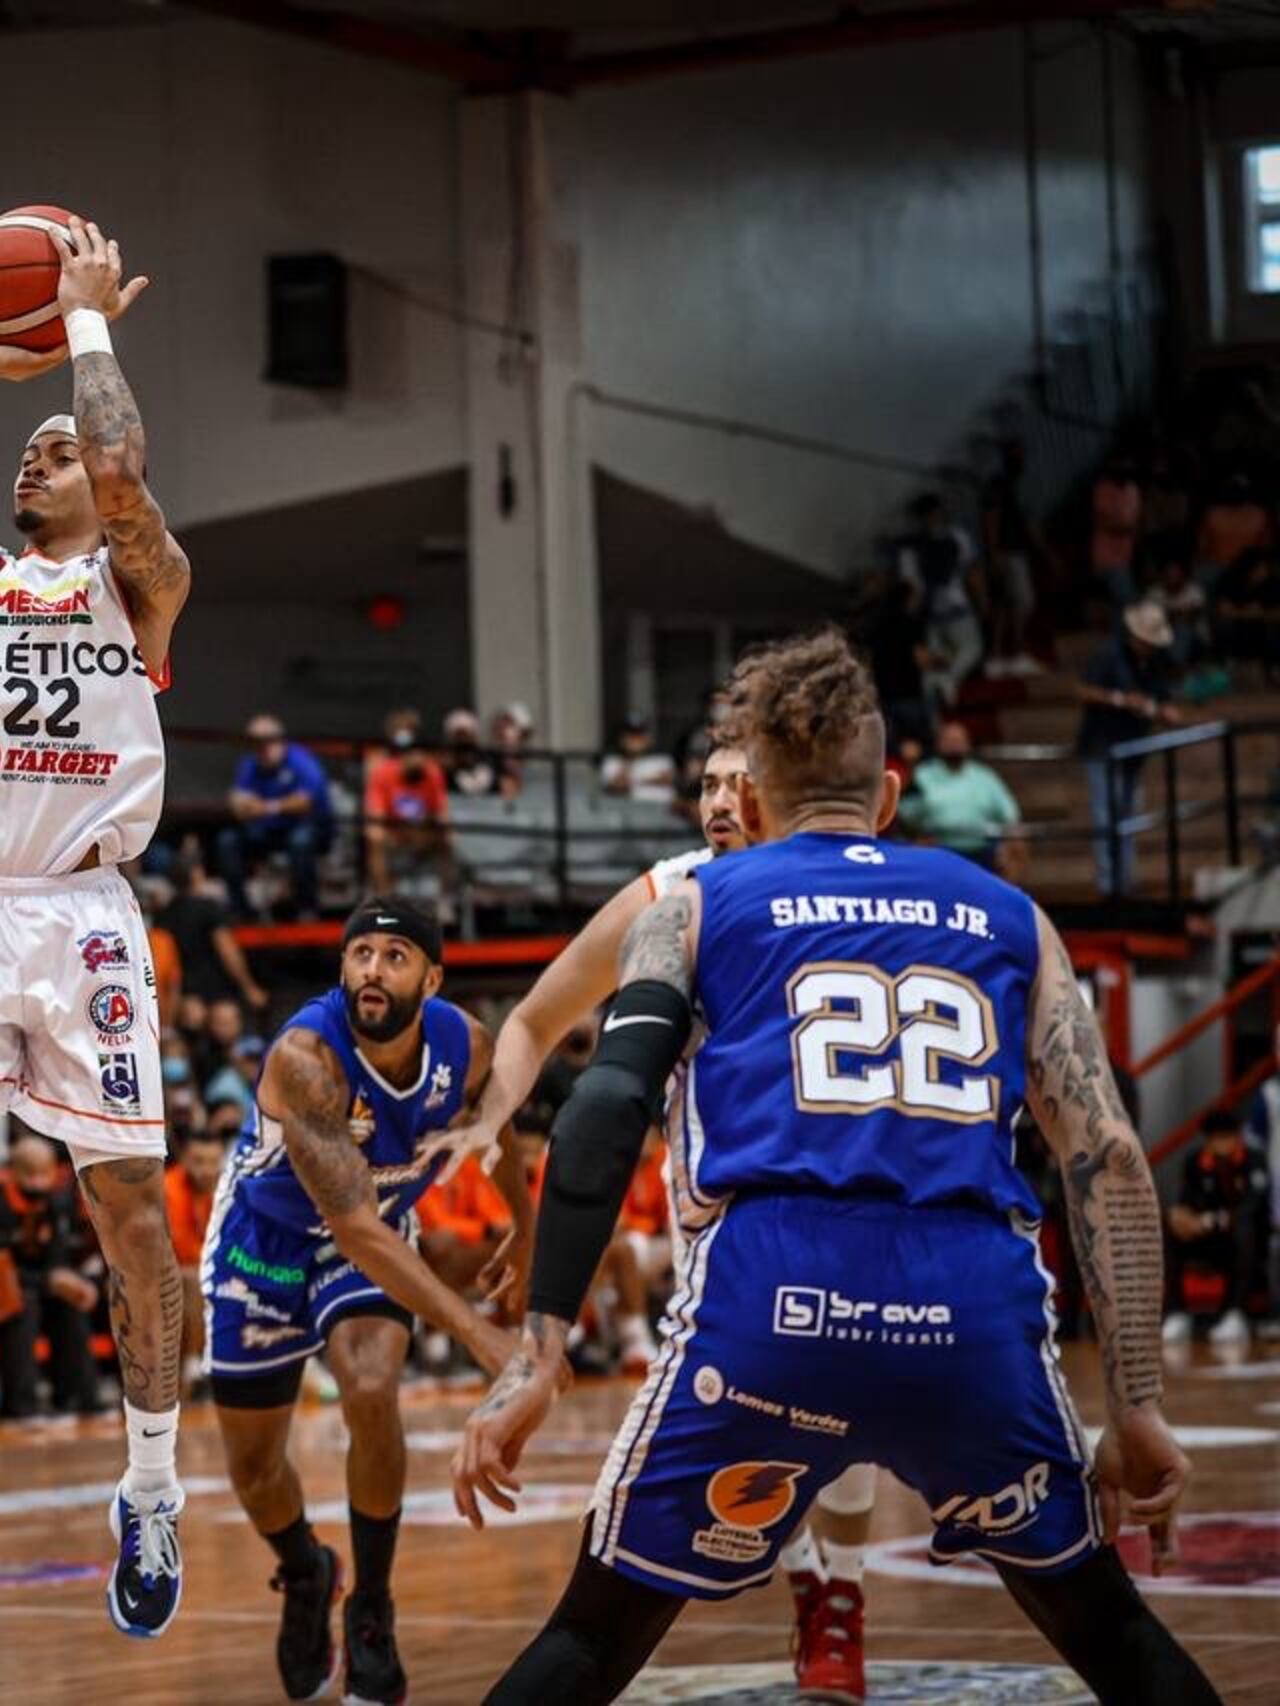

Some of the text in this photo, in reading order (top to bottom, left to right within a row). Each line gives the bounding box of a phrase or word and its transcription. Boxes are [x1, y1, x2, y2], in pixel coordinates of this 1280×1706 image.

[3, 677, 80, 738] 22
[4, 749, 118, 775] TARGET
[770, 895, 995, 940] SANTIAGO JR.
[785, 961, 1001, 1124] 22
[829, 1291, 952, 1324] brava
[827, 1325, 956, 1345] lubricants
